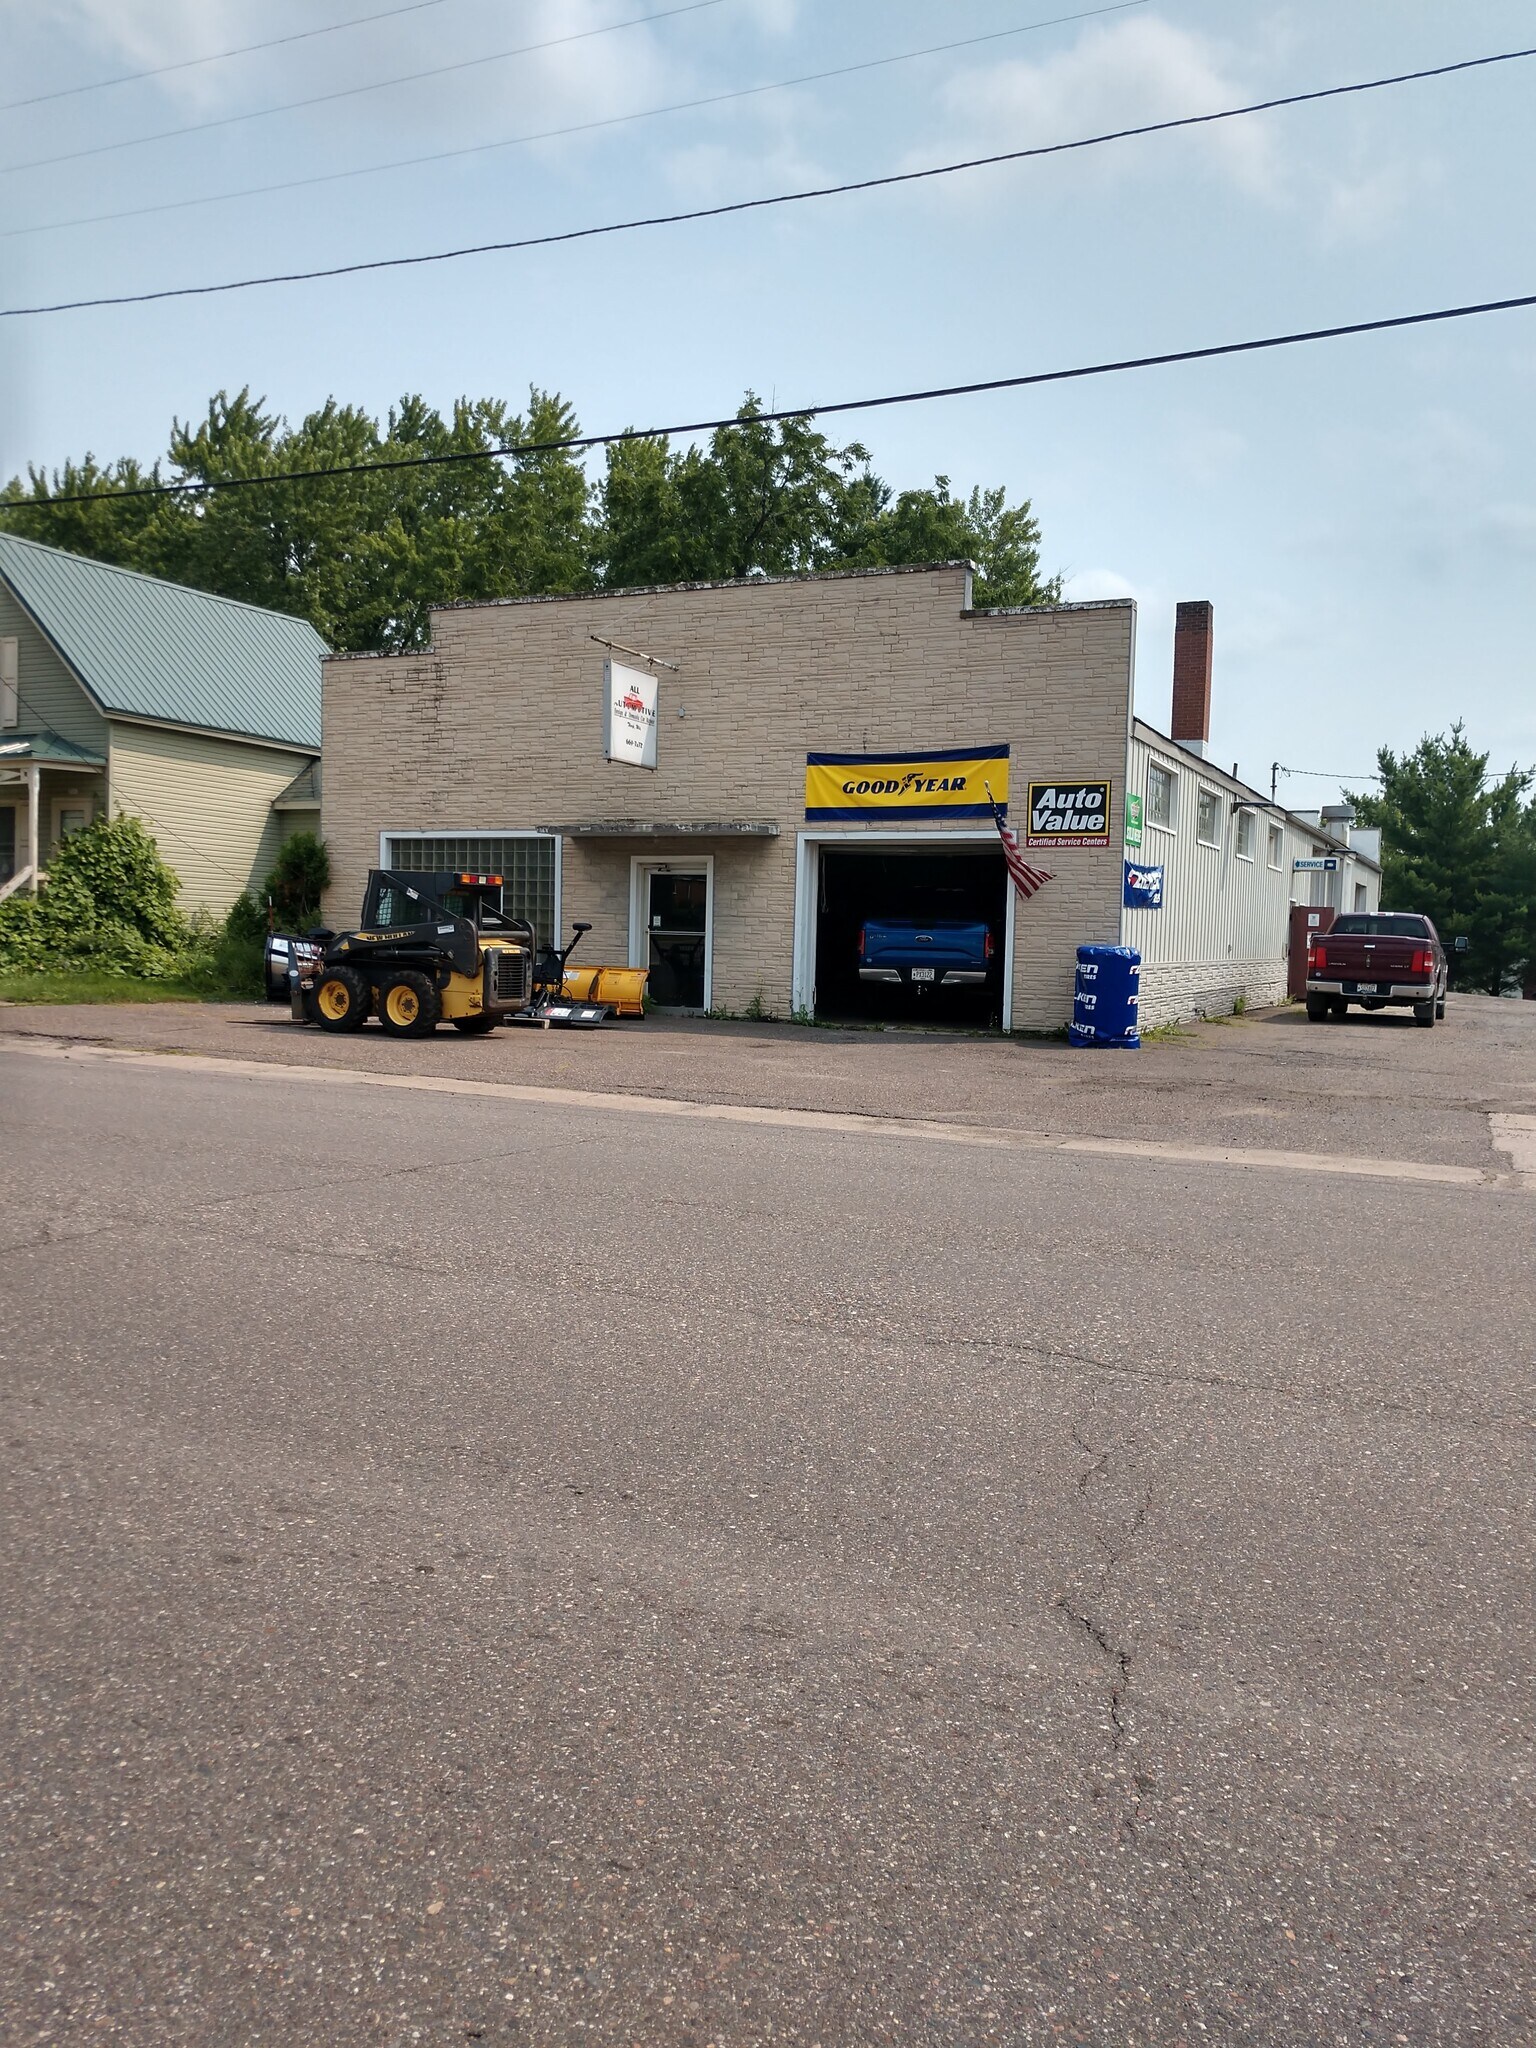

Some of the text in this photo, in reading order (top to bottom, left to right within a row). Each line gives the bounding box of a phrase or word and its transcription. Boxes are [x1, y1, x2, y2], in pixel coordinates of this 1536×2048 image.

[630, 685, 640, 694] ALL
[1035, 787, 1103, 809] Auto
[1032, 809, 1105, 831] Value
[1028, 837, 1108, 846] Certified Service Centers
